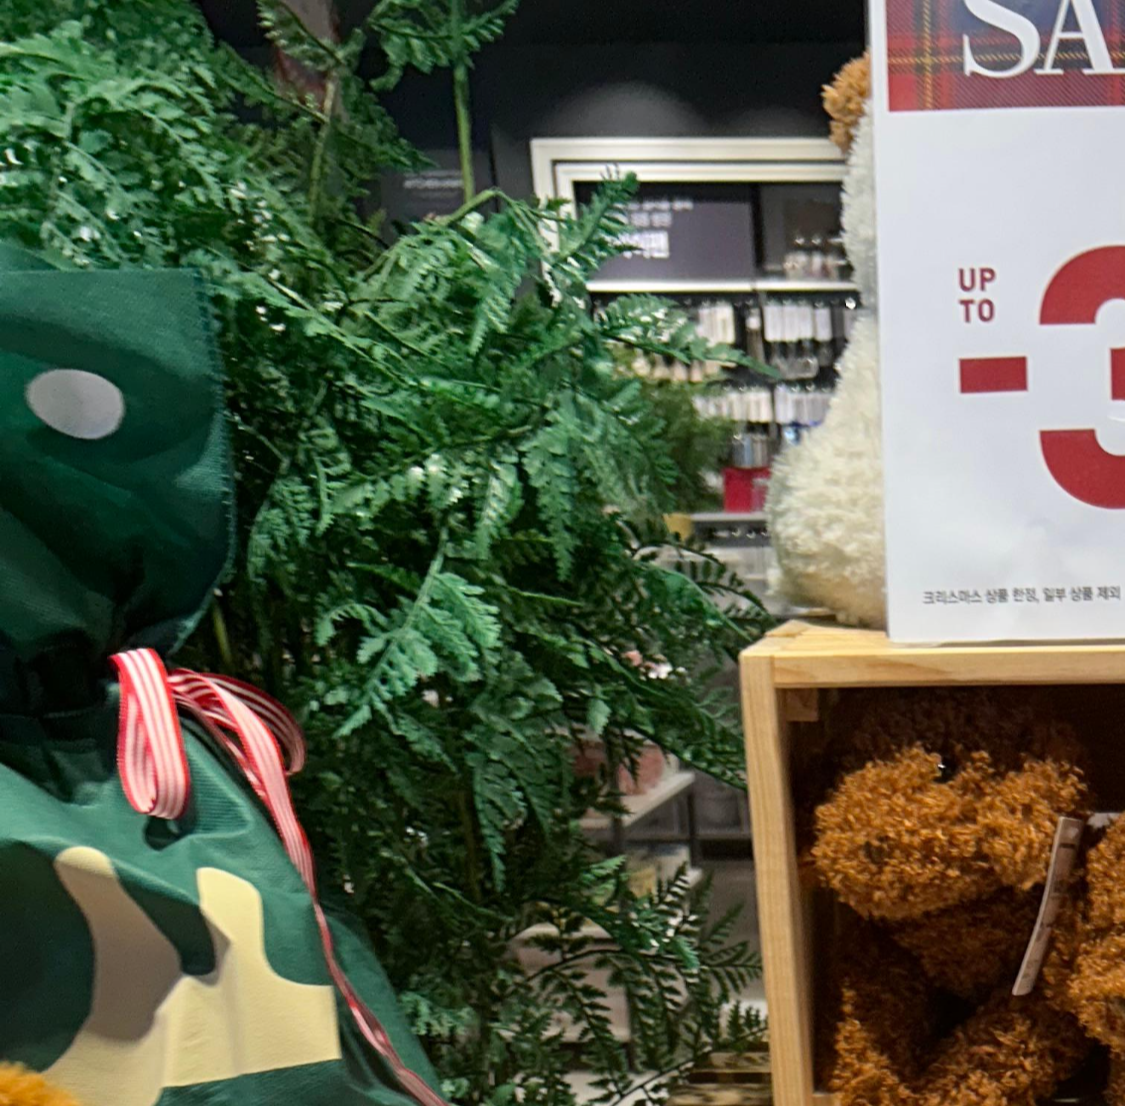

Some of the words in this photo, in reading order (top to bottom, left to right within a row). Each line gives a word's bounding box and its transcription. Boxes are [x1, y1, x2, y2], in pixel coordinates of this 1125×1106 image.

[957, 266, 997, 292] UP
[958, 298, 996, 324] TO
[922, 590, 983, 605] 크리스마스
[985, 587, 1009, 604] 상품
[1042, 587, 1067, 602] 일부
[1070, 585, 1094, 601] 상품
[1097, 585, 1122, 600] 제외
